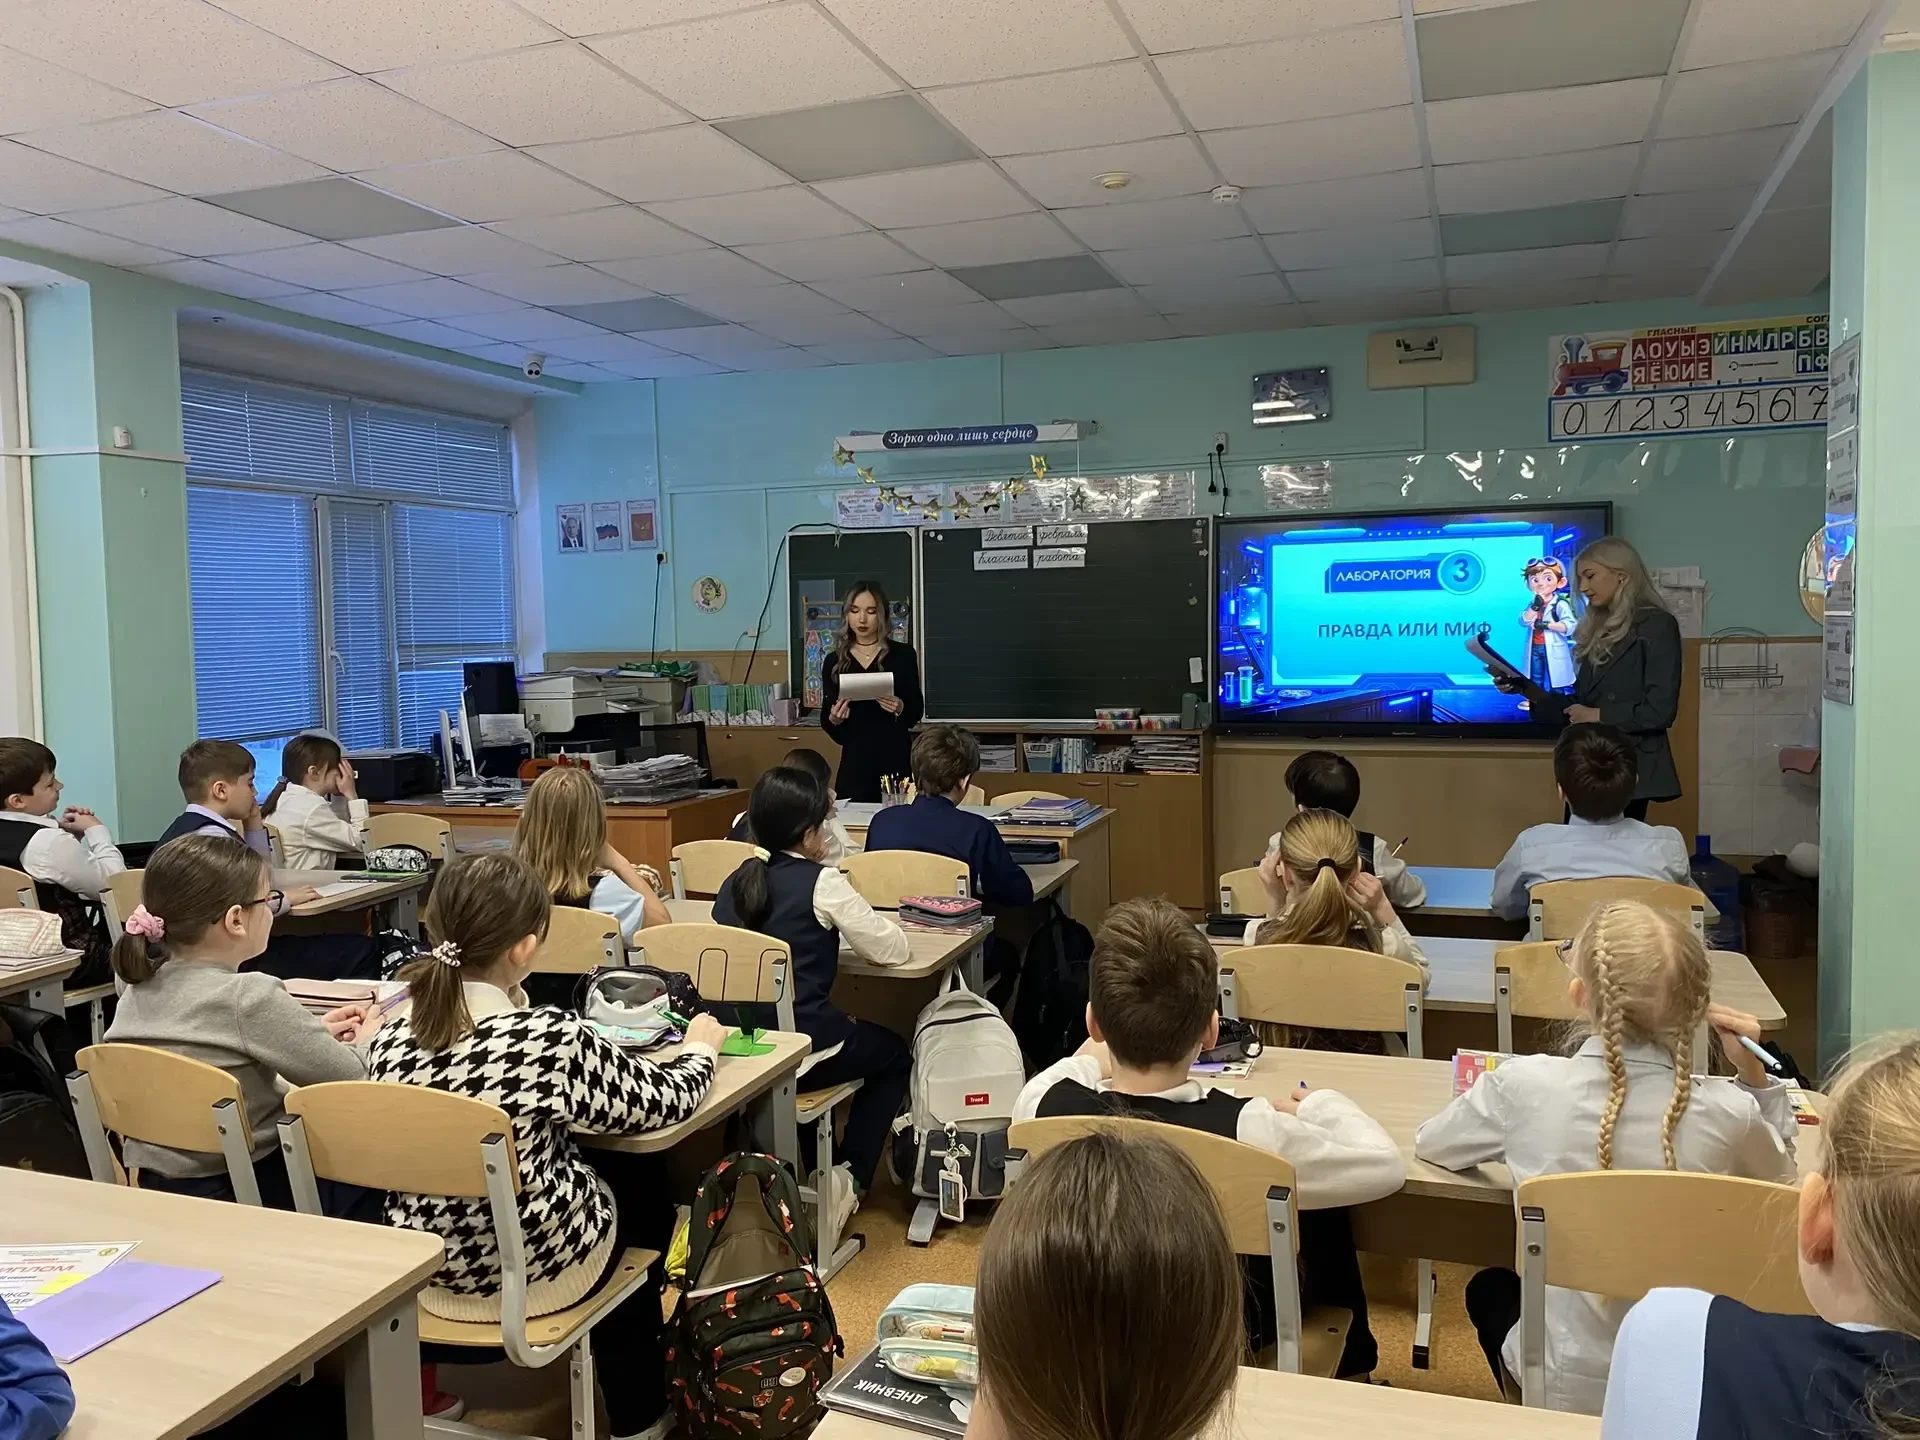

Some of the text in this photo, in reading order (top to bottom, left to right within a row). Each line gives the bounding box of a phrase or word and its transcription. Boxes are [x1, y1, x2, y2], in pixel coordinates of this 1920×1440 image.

[1647, 326, 1696, 337] ГЛАСНЫЕ
[888, 427, 1033, 446] Зорко одно лишь сердце
[985, 530, 1030, 542] Девятое
[978, 550, 1080, 567] Классная работа
[1336, 558, 1470, 582] ЛАБОРАТОРИЯ 3
[1318, 620, 1492, 640] ПРАВДА ИЛИ МИФ
[0, 1265, 75, 1273] ИПЛОМ
[853, 1380, 928, 1404] ДНЕВНИК
